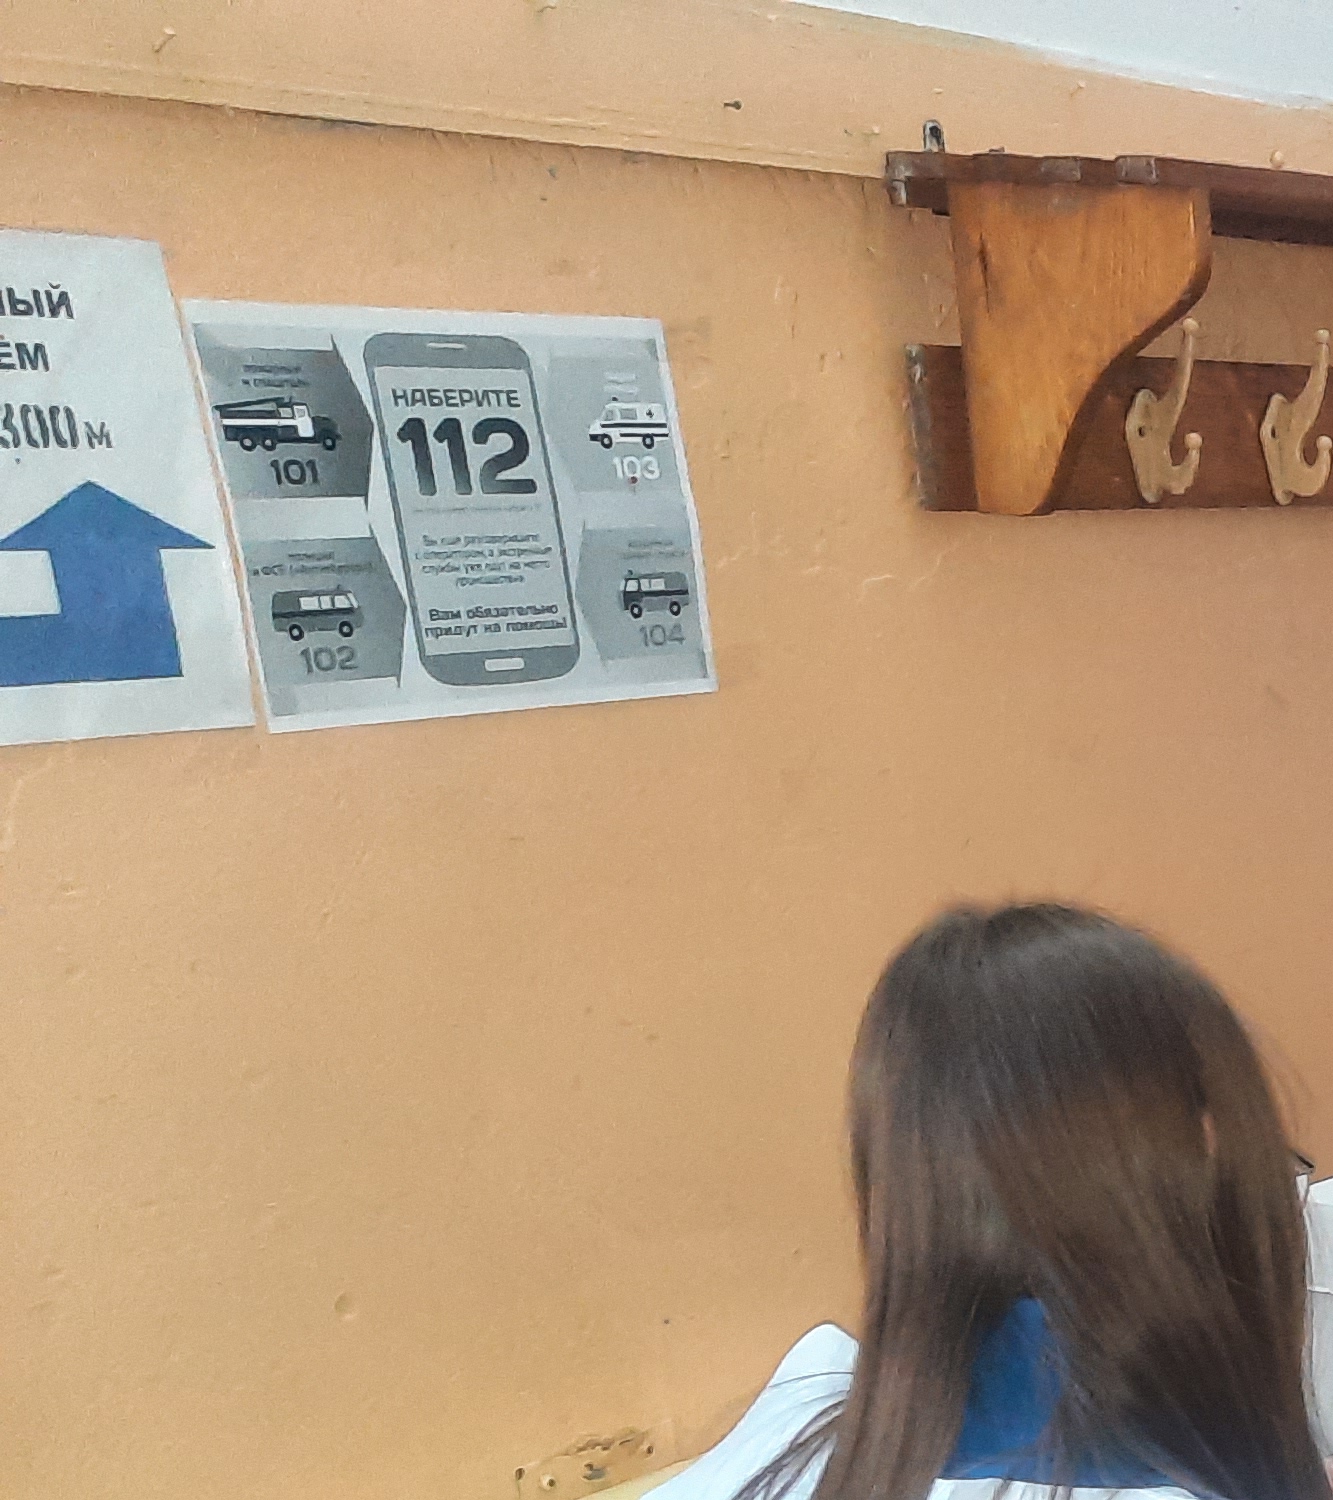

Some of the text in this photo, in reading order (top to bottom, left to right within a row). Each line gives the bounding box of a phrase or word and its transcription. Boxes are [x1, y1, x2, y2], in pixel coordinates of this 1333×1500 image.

[391, 387, 521, 408] НАБЕРИТЕ
[396, 416, 538, 497] 112
[612, 455, 661, 480] 103
[269, 458, 319, 486] 101
[639, 623, 687, 647] 104
[299, 645, 359, 675] 102
